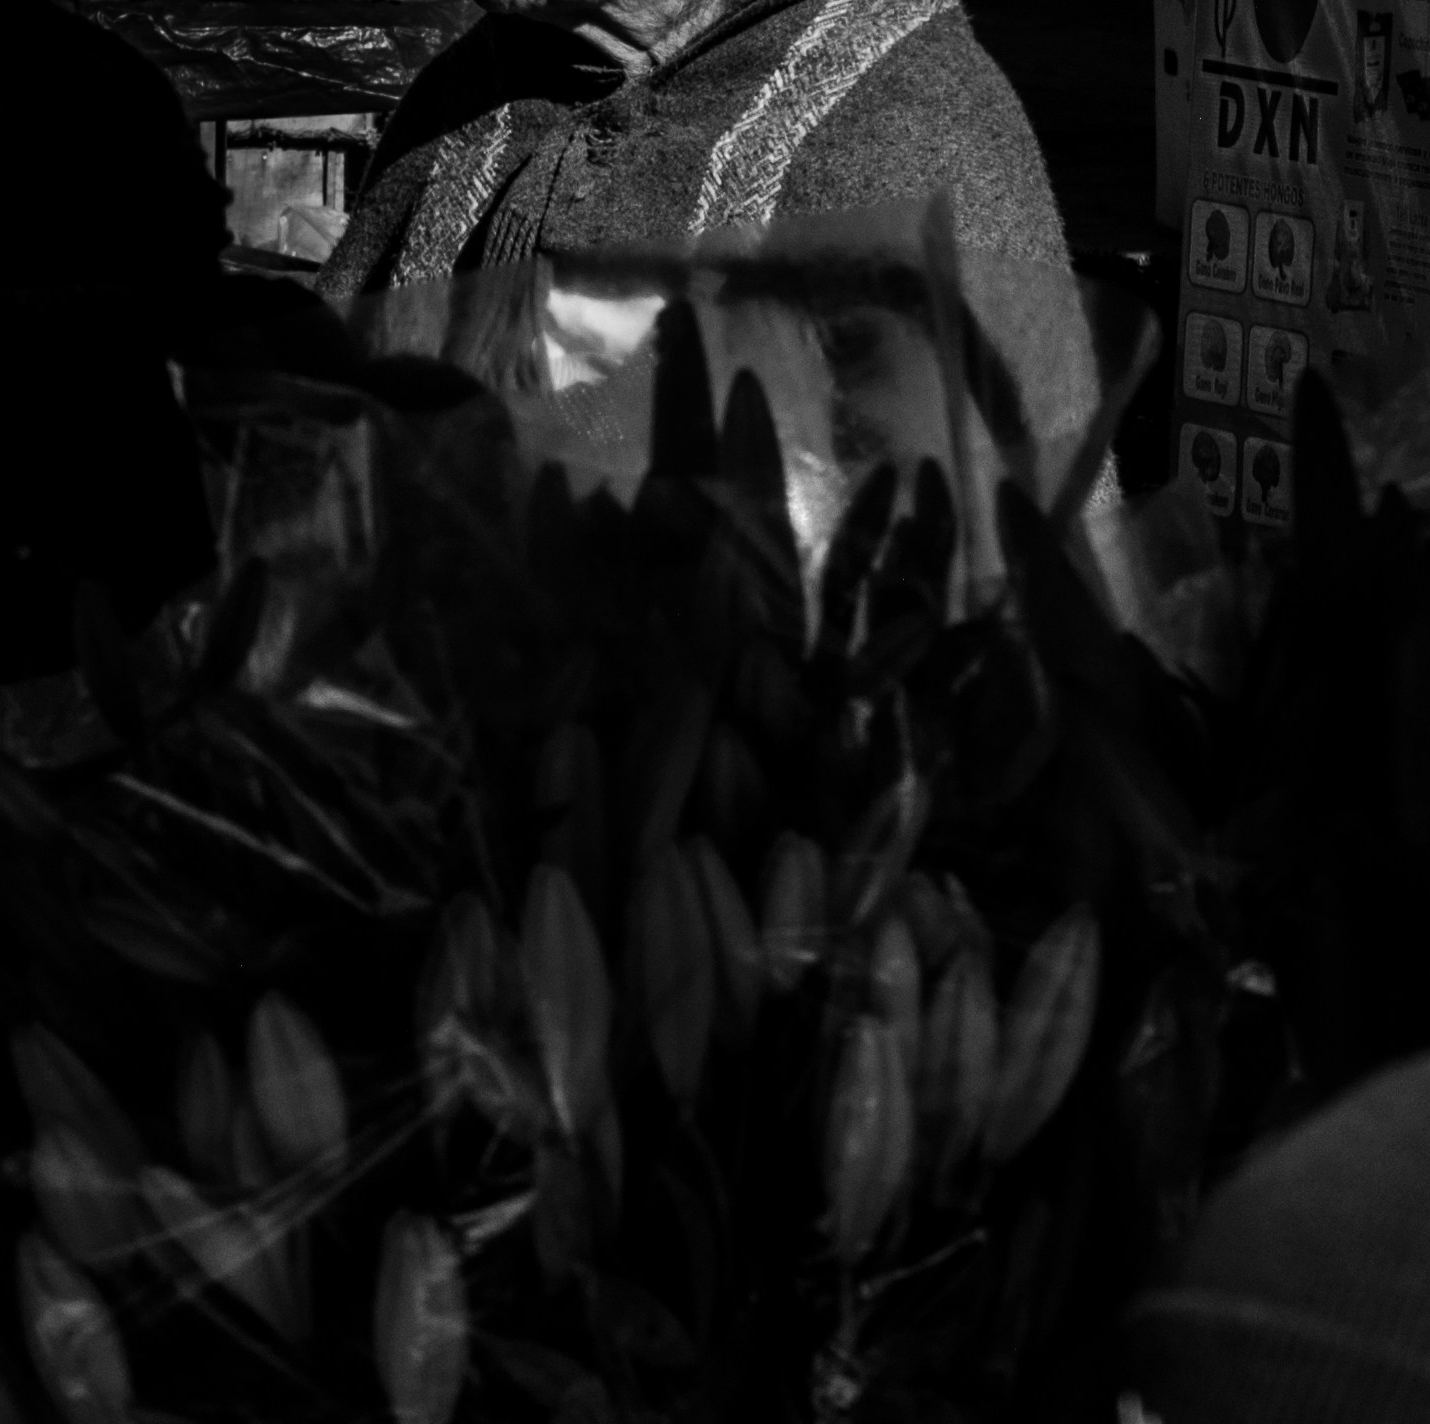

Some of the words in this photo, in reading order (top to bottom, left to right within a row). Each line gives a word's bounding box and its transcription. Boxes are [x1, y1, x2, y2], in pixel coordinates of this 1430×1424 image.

[1217, 82, 1319, 165] DXN
[1202, 171, 1209, 189] 6
[1211, 172, 1261, 200] POTENTES
[1264, 181, 1305, 207] HONGOS
